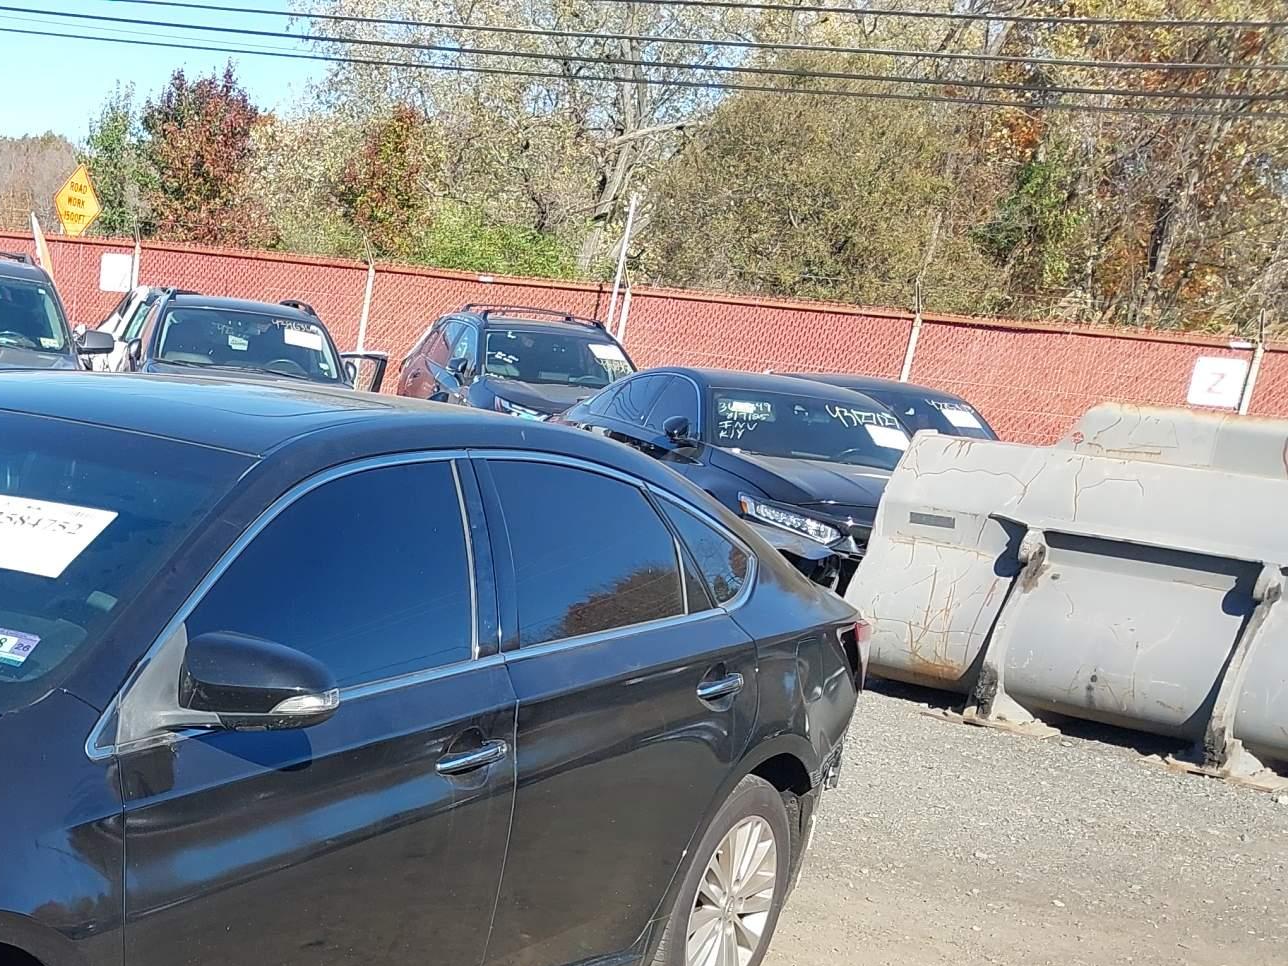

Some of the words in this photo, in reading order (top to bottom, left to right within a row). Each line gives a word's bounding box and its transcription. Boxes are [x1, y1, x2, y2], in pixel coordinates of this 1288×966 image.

[70, 181, 88, 194] ROAD
[68, 196, 85, 208] WORK
[14, 643, 32, 653] 26
